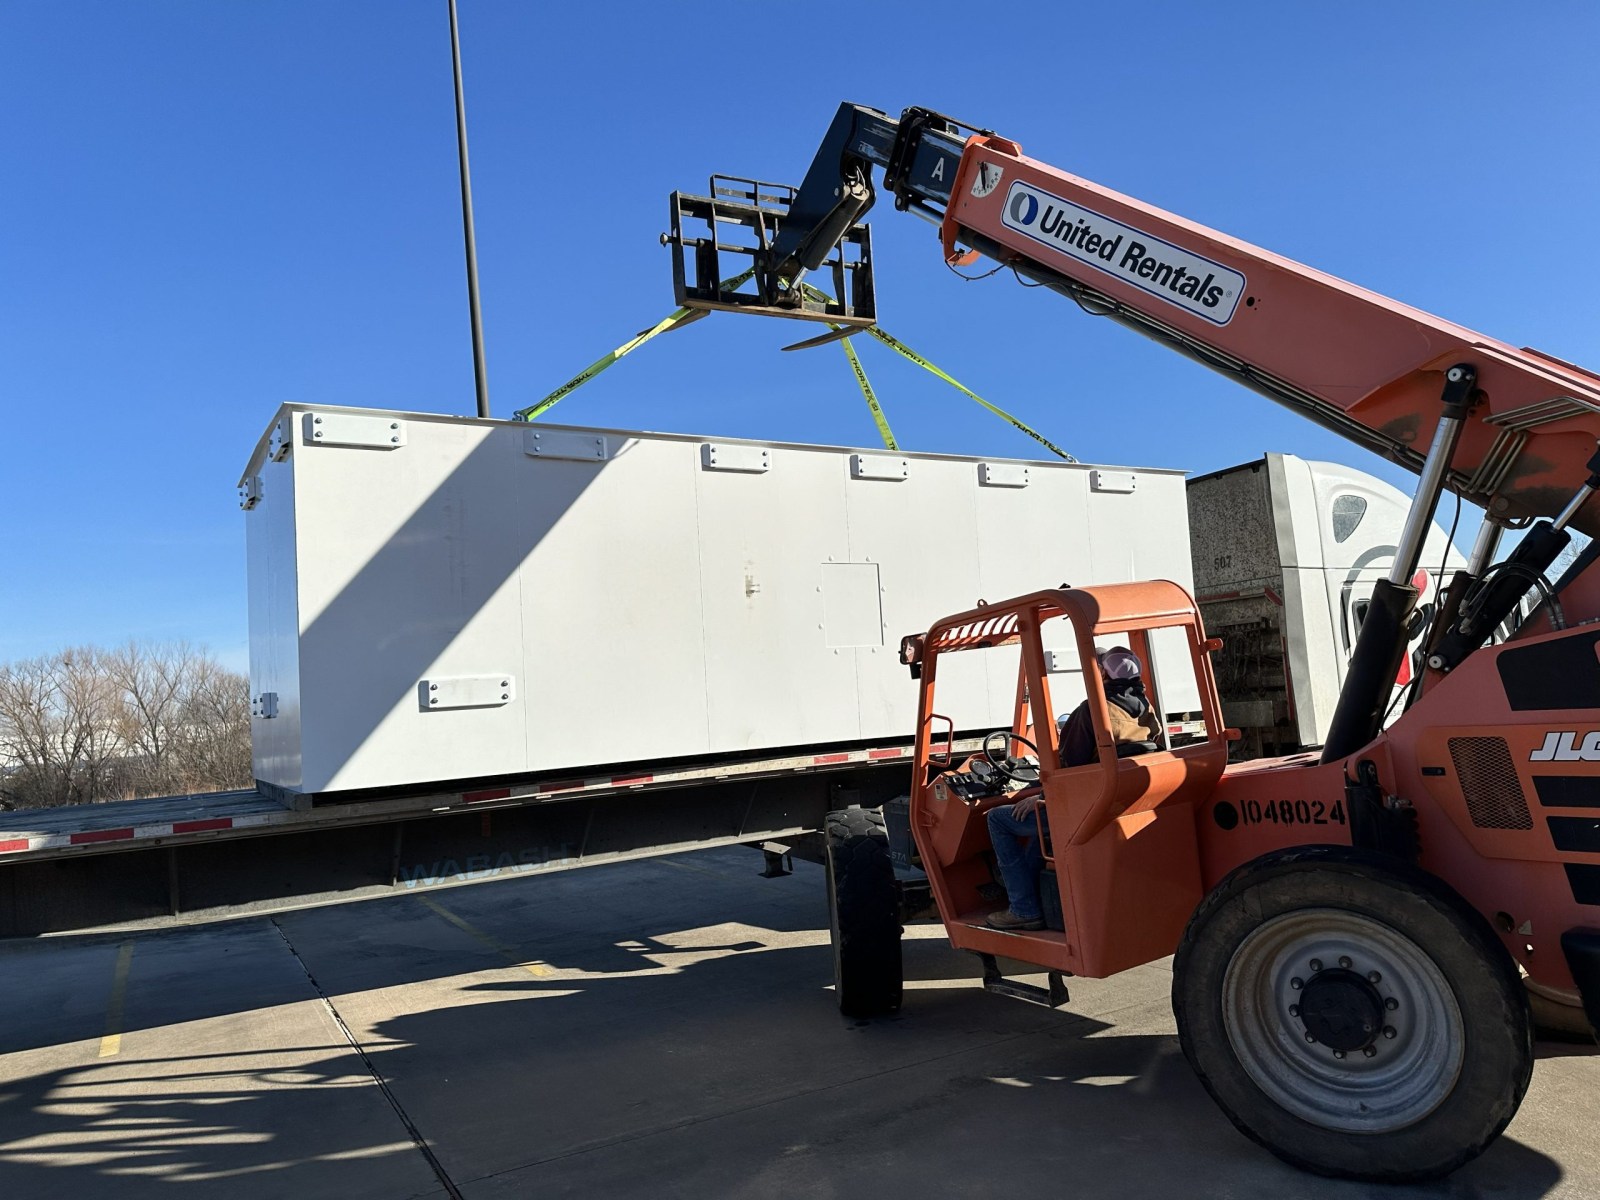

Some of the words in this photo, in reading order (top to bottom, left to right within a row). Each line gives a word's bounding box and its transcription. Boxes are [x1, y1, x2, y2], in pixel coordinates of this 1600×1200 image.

[930, 157, 945, 182] A
[1040, 205, 1123, 262] United
[1119, 240, 1224, 309] Rentals
[1213, 555, 1232, 572] 507
[1240, 799, 1346, 828] 1048024
[400, 841, 569, 889] WABASH
